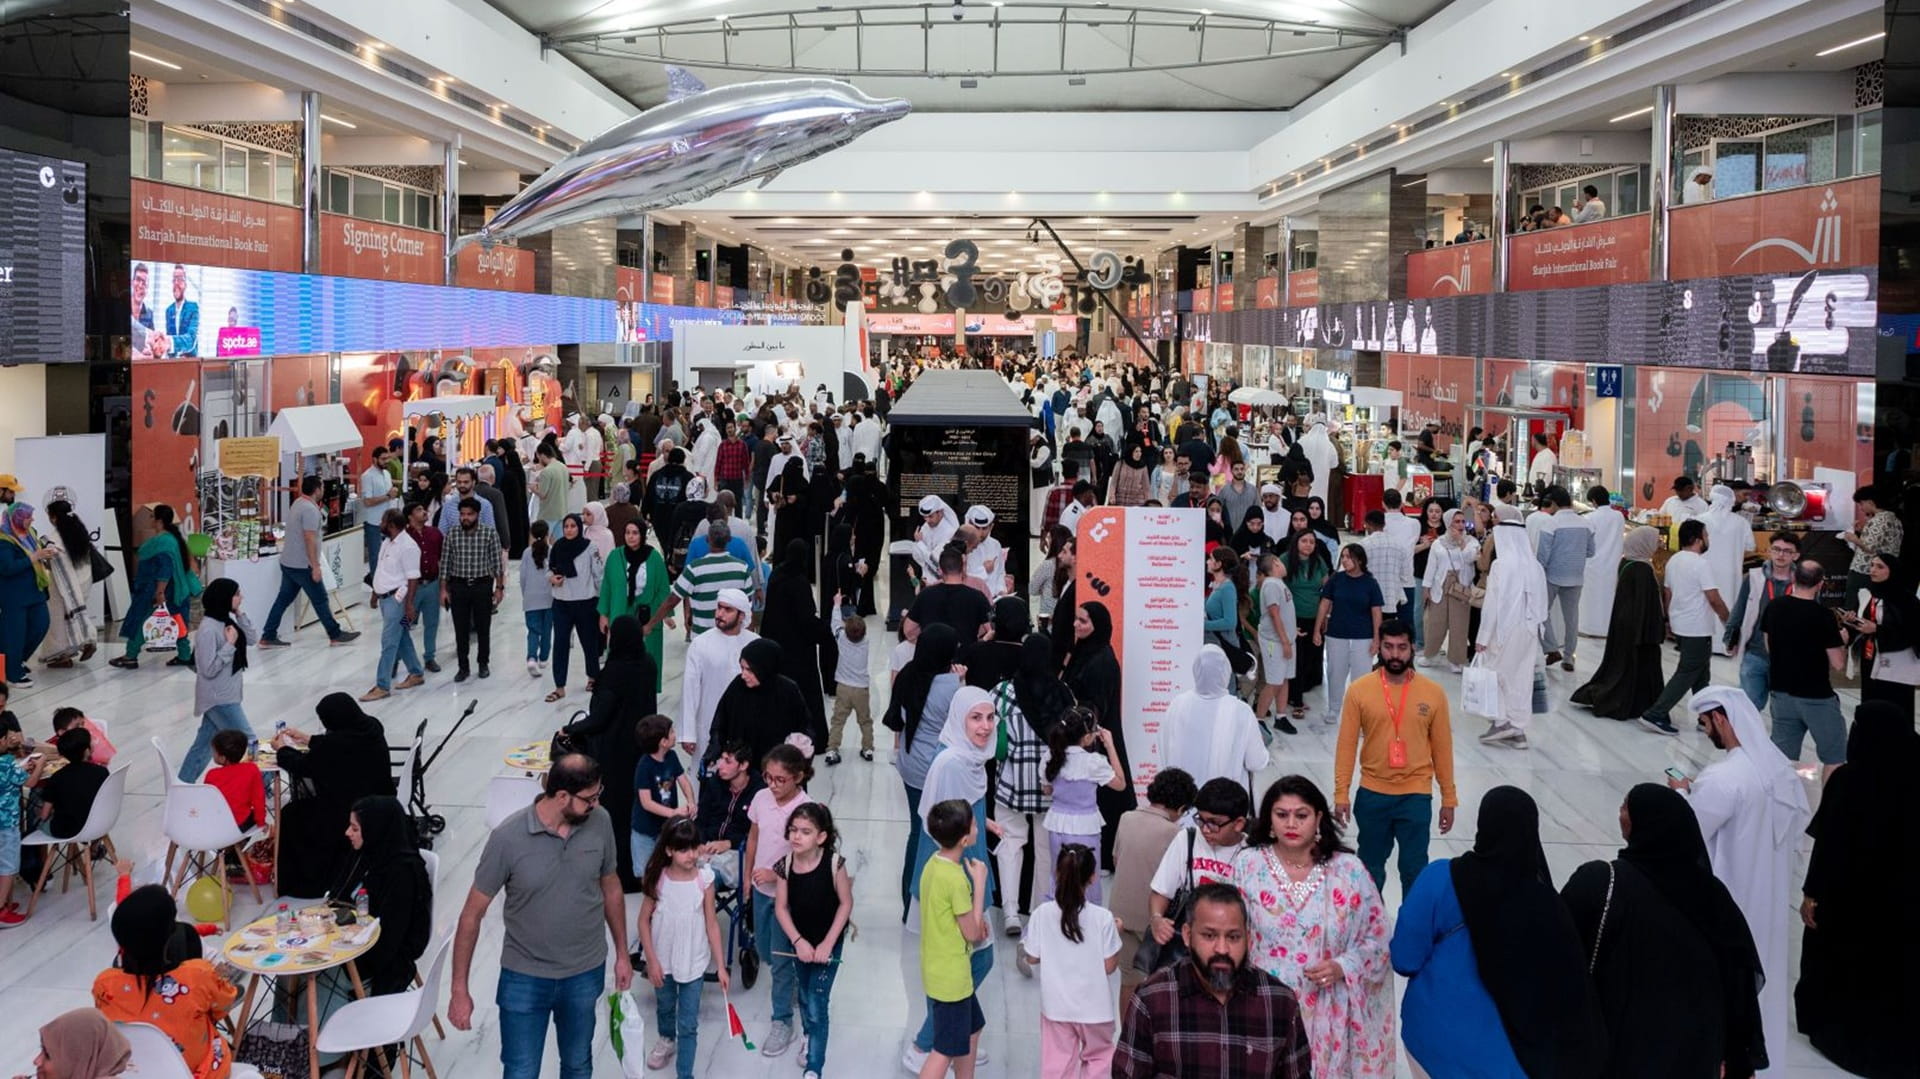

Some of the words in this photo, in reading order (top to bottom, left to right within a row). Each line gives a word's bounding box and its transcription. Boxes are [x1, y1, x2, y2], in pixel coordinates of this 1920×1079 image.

[241, 216, 267, 229] معرض
[138, 226, 175, 246] Sharjah
[177, 231, 233, 249] International
[234, 238, 254, 252] Book
[254, 240, 268, 253] Fair
[343, 223, 388, 258] Signing
[390, 232, 424, 257] Corner
[504, 254, 516, 278] ركن
[1532, 263, 1551, 277] Sharjah
[1552, 260, 1588, 273] International
[1589, 258, 1604, 270] Book
[1605, 257, 1617, 268] Fair
